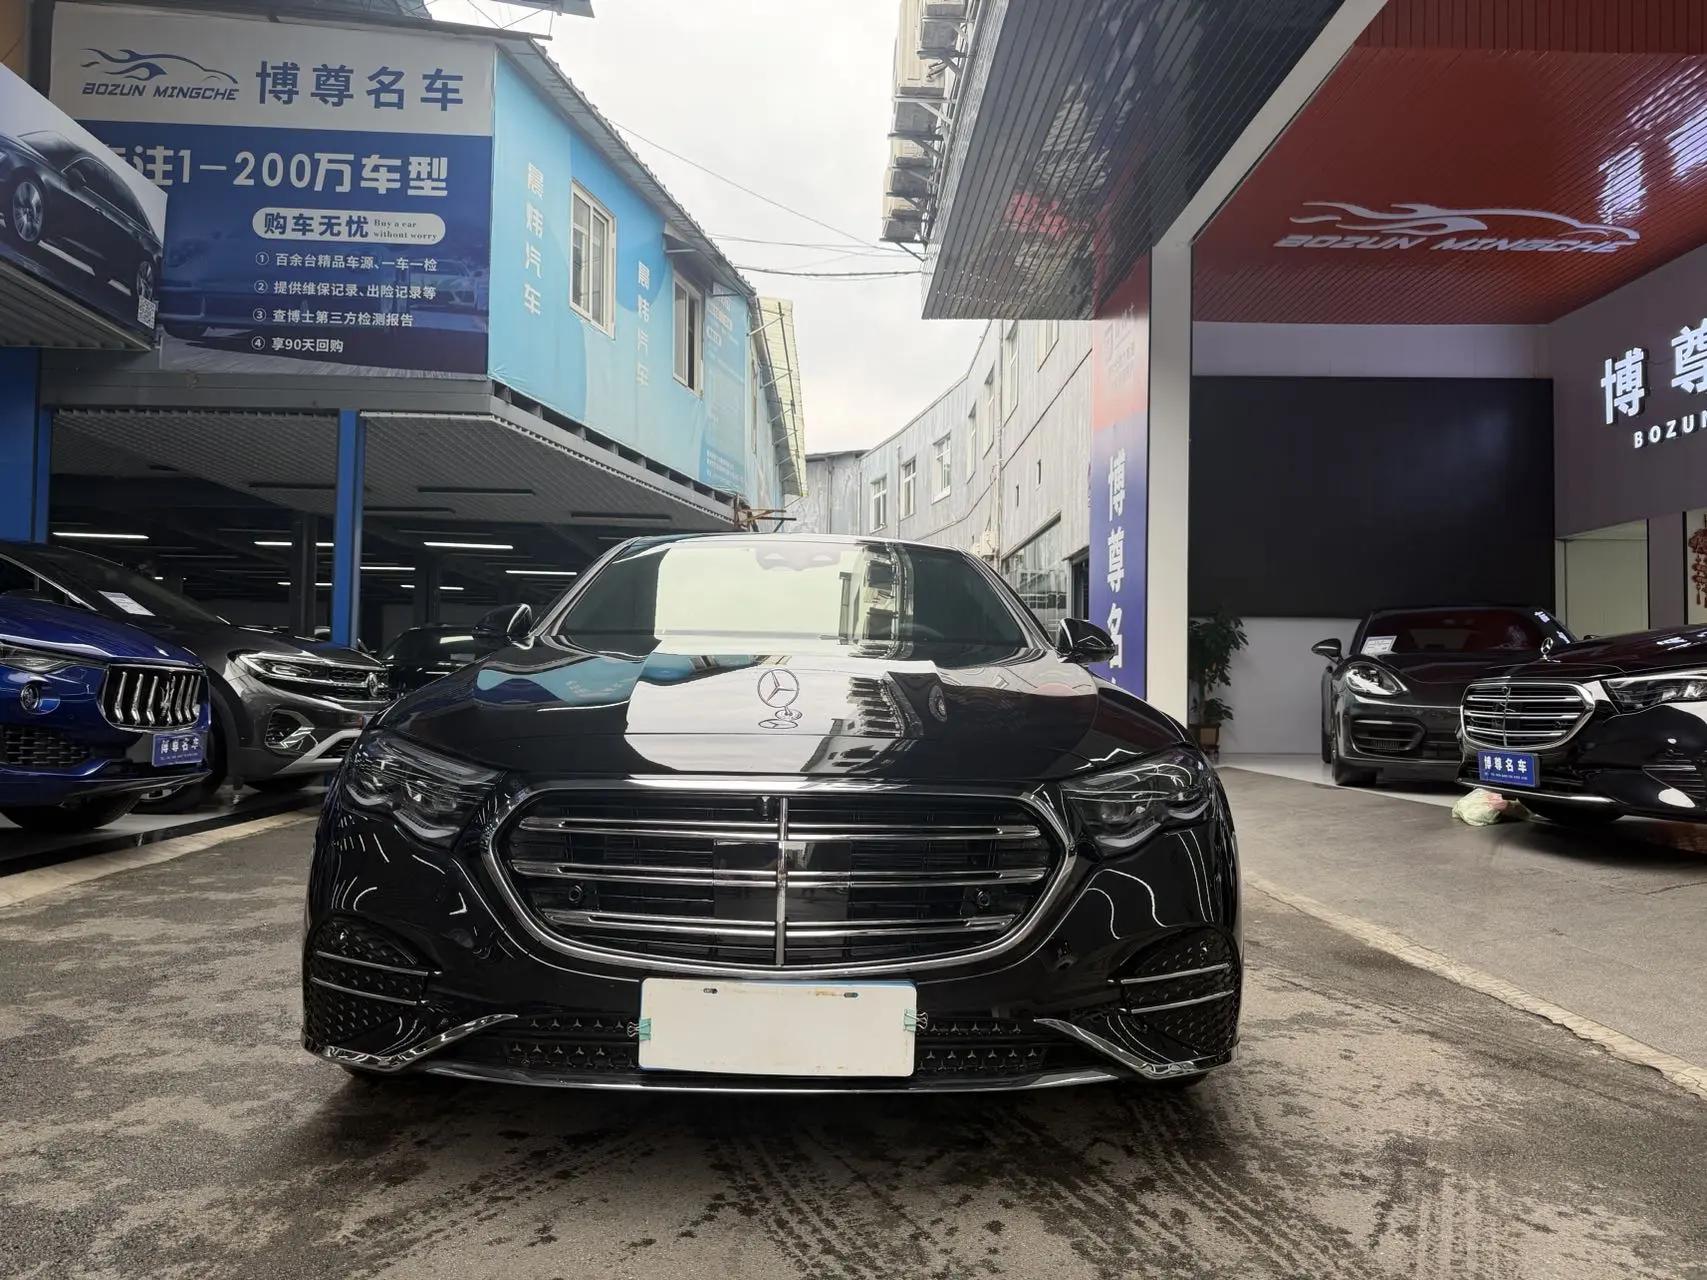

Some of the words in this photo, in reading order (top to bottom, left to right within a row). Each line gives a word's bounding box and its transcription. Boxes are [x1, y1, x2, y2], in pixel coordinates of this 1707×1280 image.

[82, 83, 146, 97] BOZUN
[153, 86, 239, 101] MINGCHE
[256, 61, 463, 111] 博尊名车
[264, 212, 369, 238] 购车无忧
[374, 220, 391, 229] Buy
[374, 231, 407, 239] without
[410, 233, 438, 241] worry
[1273, 234, 1427, 250] BOZUN
[1430, 237, 1632, 254] MINGCHE
[275, 253, 437, 272] 百余台精品车源、一车一检
[273, 281, 437, 300] 提供维保记录、出险记录等
[272, 309, 413, 327] 查博士第三方检测报告
[271, 337, 344, 353] 享90天回购
[1107, 448, 1126, 684] 博尊名
[1484, 755, 1527, 773] 博尊名车
